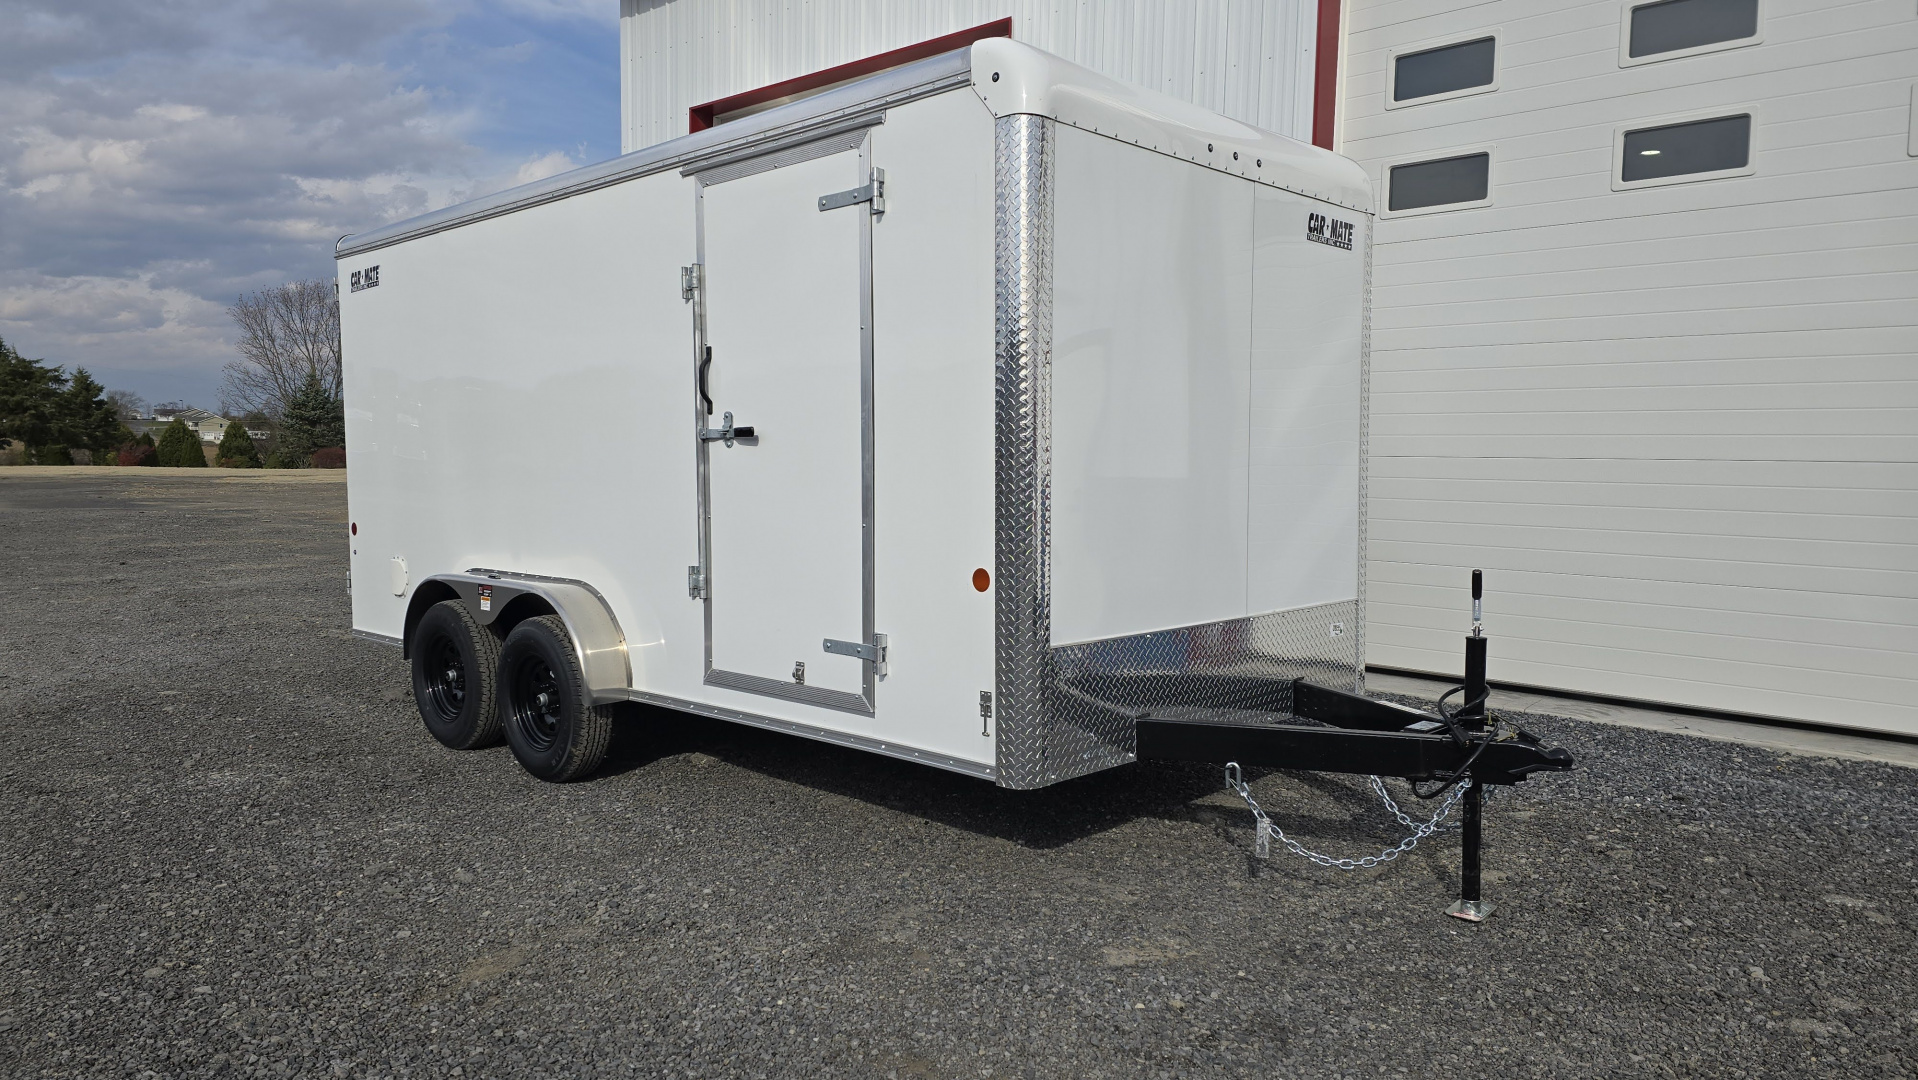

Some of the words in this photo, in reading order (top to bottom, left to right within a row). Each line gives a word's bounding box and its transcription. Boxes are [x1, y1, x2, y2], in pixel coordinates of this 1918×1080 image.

[1308, 212, 1326, 236] CAR
[1330, 218, 1353, 243] MATE
[351, 270, 361, 288] CAR
[364, 265, 380, 283] MATE
